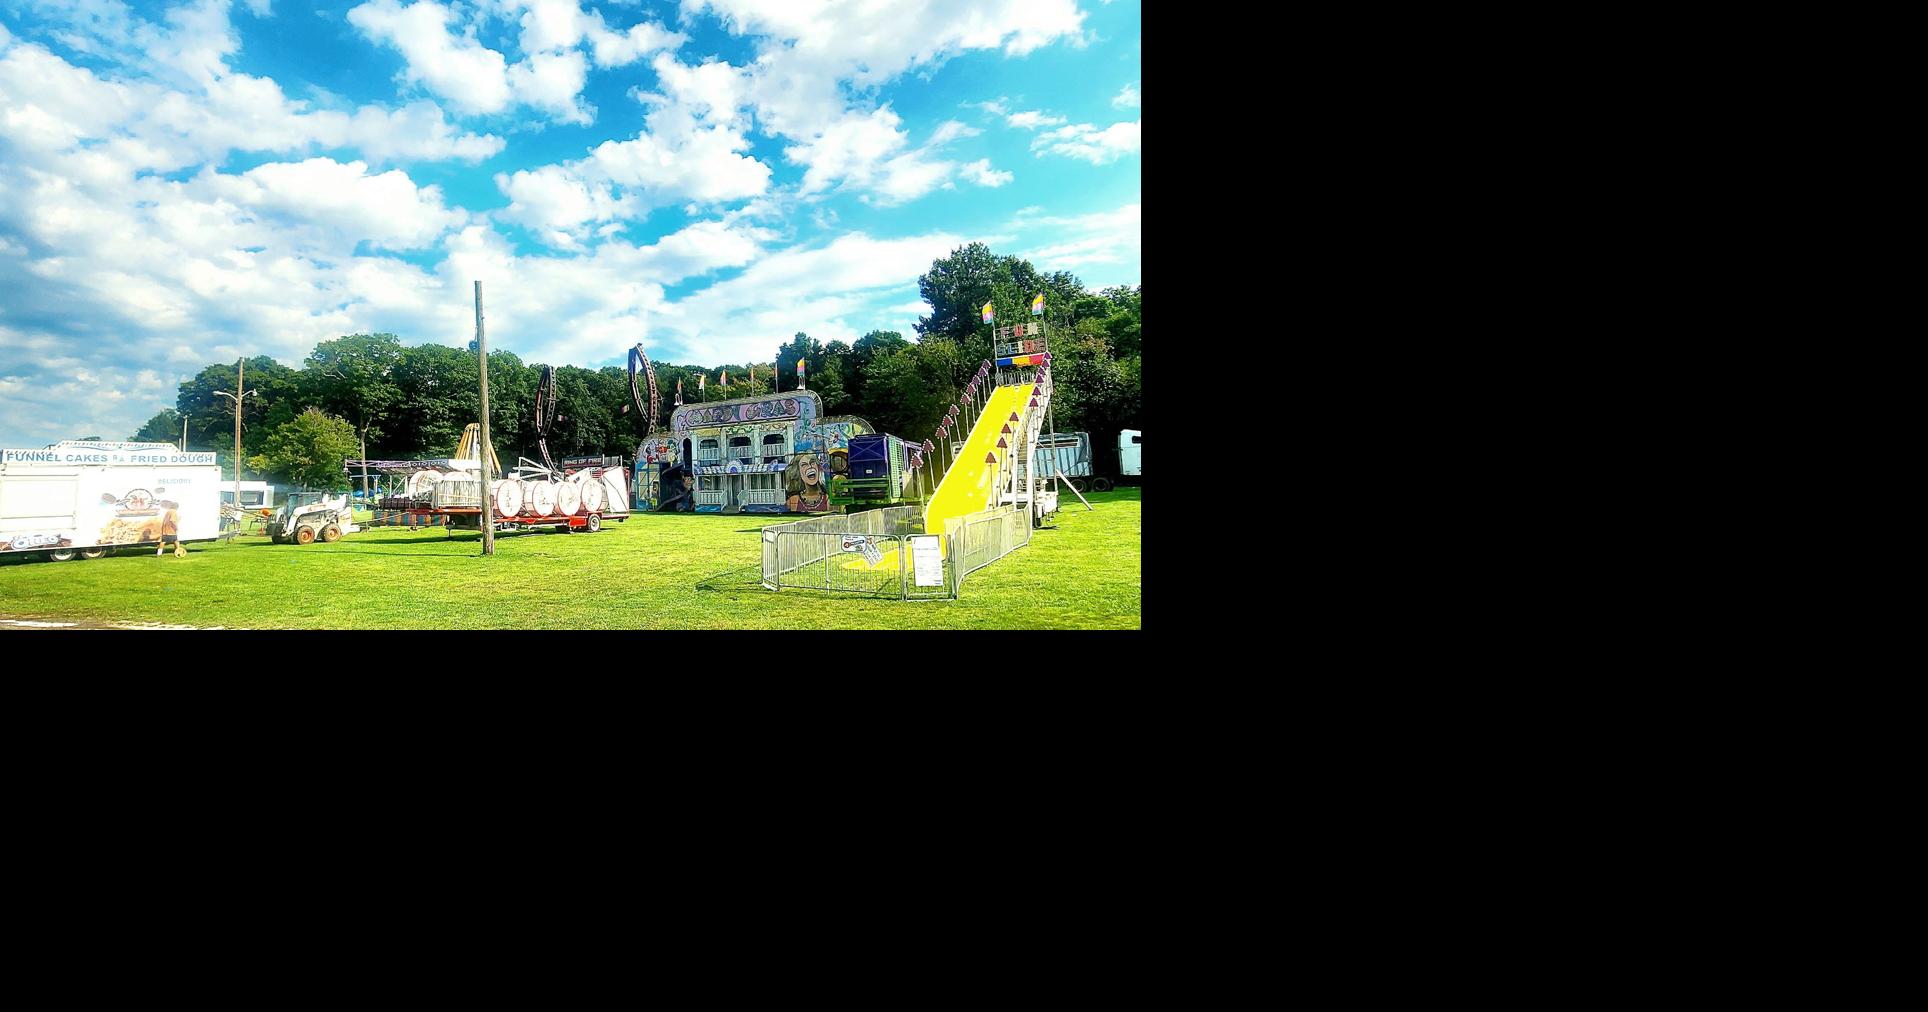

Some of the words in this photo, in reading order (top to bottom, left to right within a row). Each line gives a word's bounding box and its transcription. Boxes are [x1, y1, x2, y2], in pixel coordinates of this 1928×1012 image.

[1000, 322, 1038, 338] FUN
[996, 338, 1047, 356] SLIDE
[686, 405, 740, 424] MARDI
[746, 399, 796, 419] GRAS
[7, 453, 61, 462] FUNNEL
[66, 454, 108, 462] CAKES
[131, 455, 167, 463] FRIED
[171, 455, 213, 463] DOUGH
